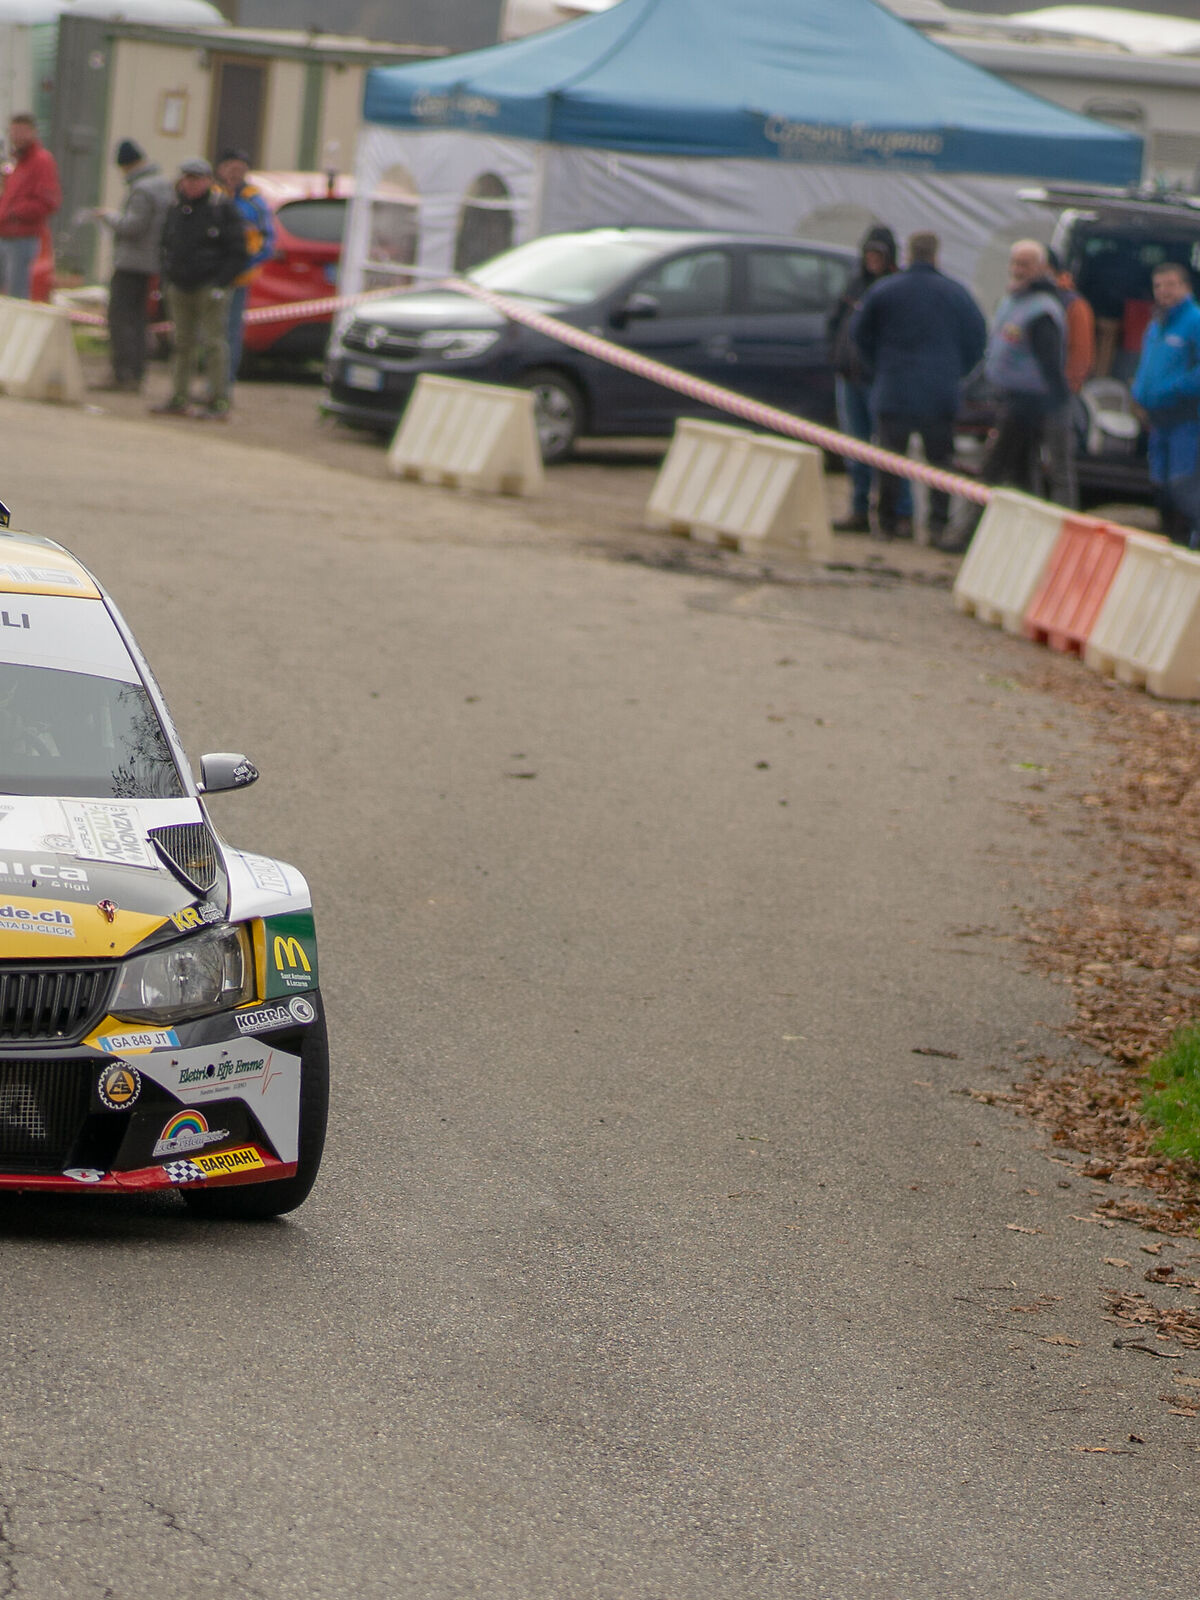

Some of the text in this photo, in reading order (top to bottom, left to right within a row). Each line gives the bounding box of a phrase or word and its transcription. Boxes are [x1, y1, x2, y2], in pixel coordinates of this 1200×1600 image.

[169, 906, 205, 932] KR
[37, 925, 73, 936] CLICK
[236, 1006, 291, 1028] KOBRA
[111, 1033, 167, 1048] GA 849 JT
[179, 1059, 264, 1084] Elettri Effe Emme
[200, 1150, 260, 1172] BARDAHL
